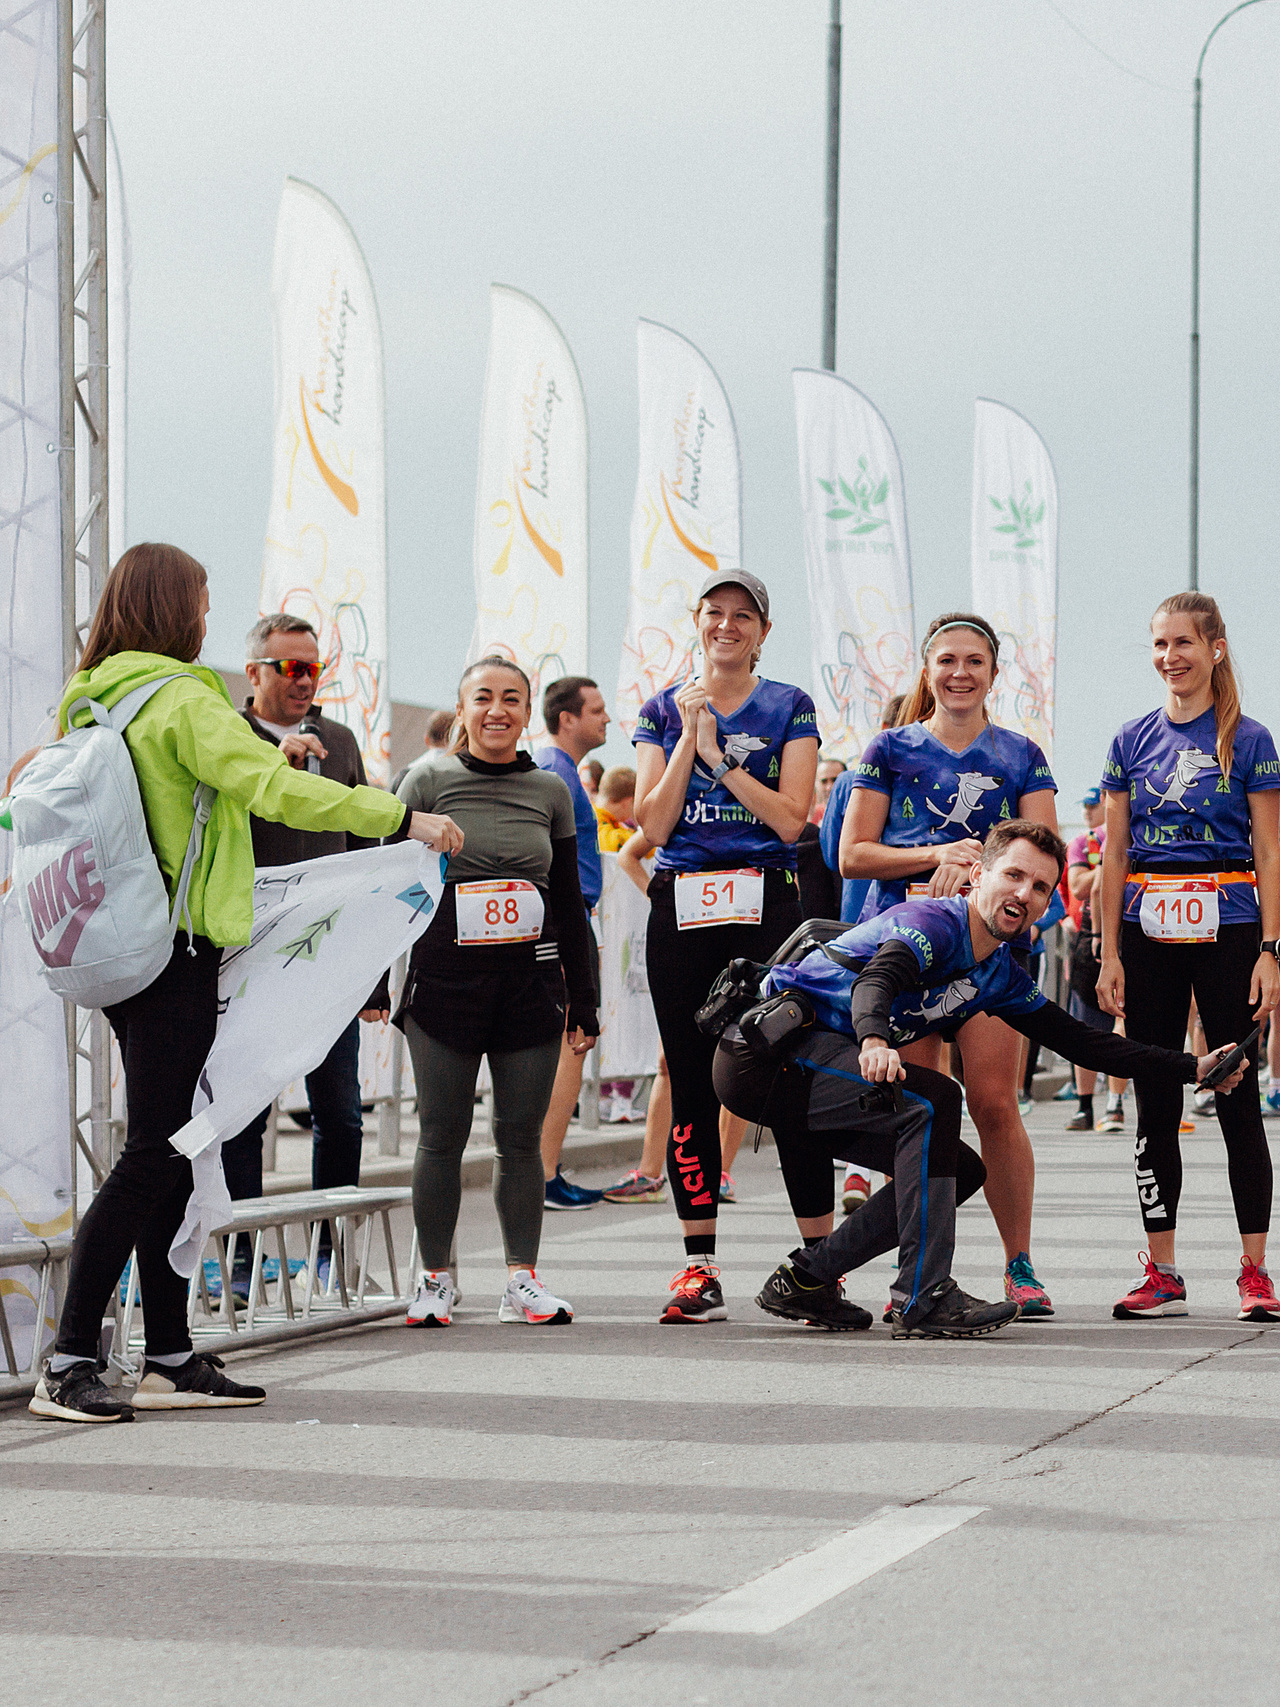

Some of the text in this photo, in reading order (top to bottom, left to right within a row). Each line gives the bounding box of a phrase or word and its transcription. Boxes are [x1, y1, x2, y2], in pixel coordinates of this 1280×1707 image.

[321, 287, 358, 426] handicap
[530, 379, 561, 498] handicap
[680, 406, 715, 509] handicap
[27, 837, 103, 940] NIKE
[484, 898, 519, 926] 88
[701, 880, 734, 907] 51
[1153, 898, 1203, 925] 110
